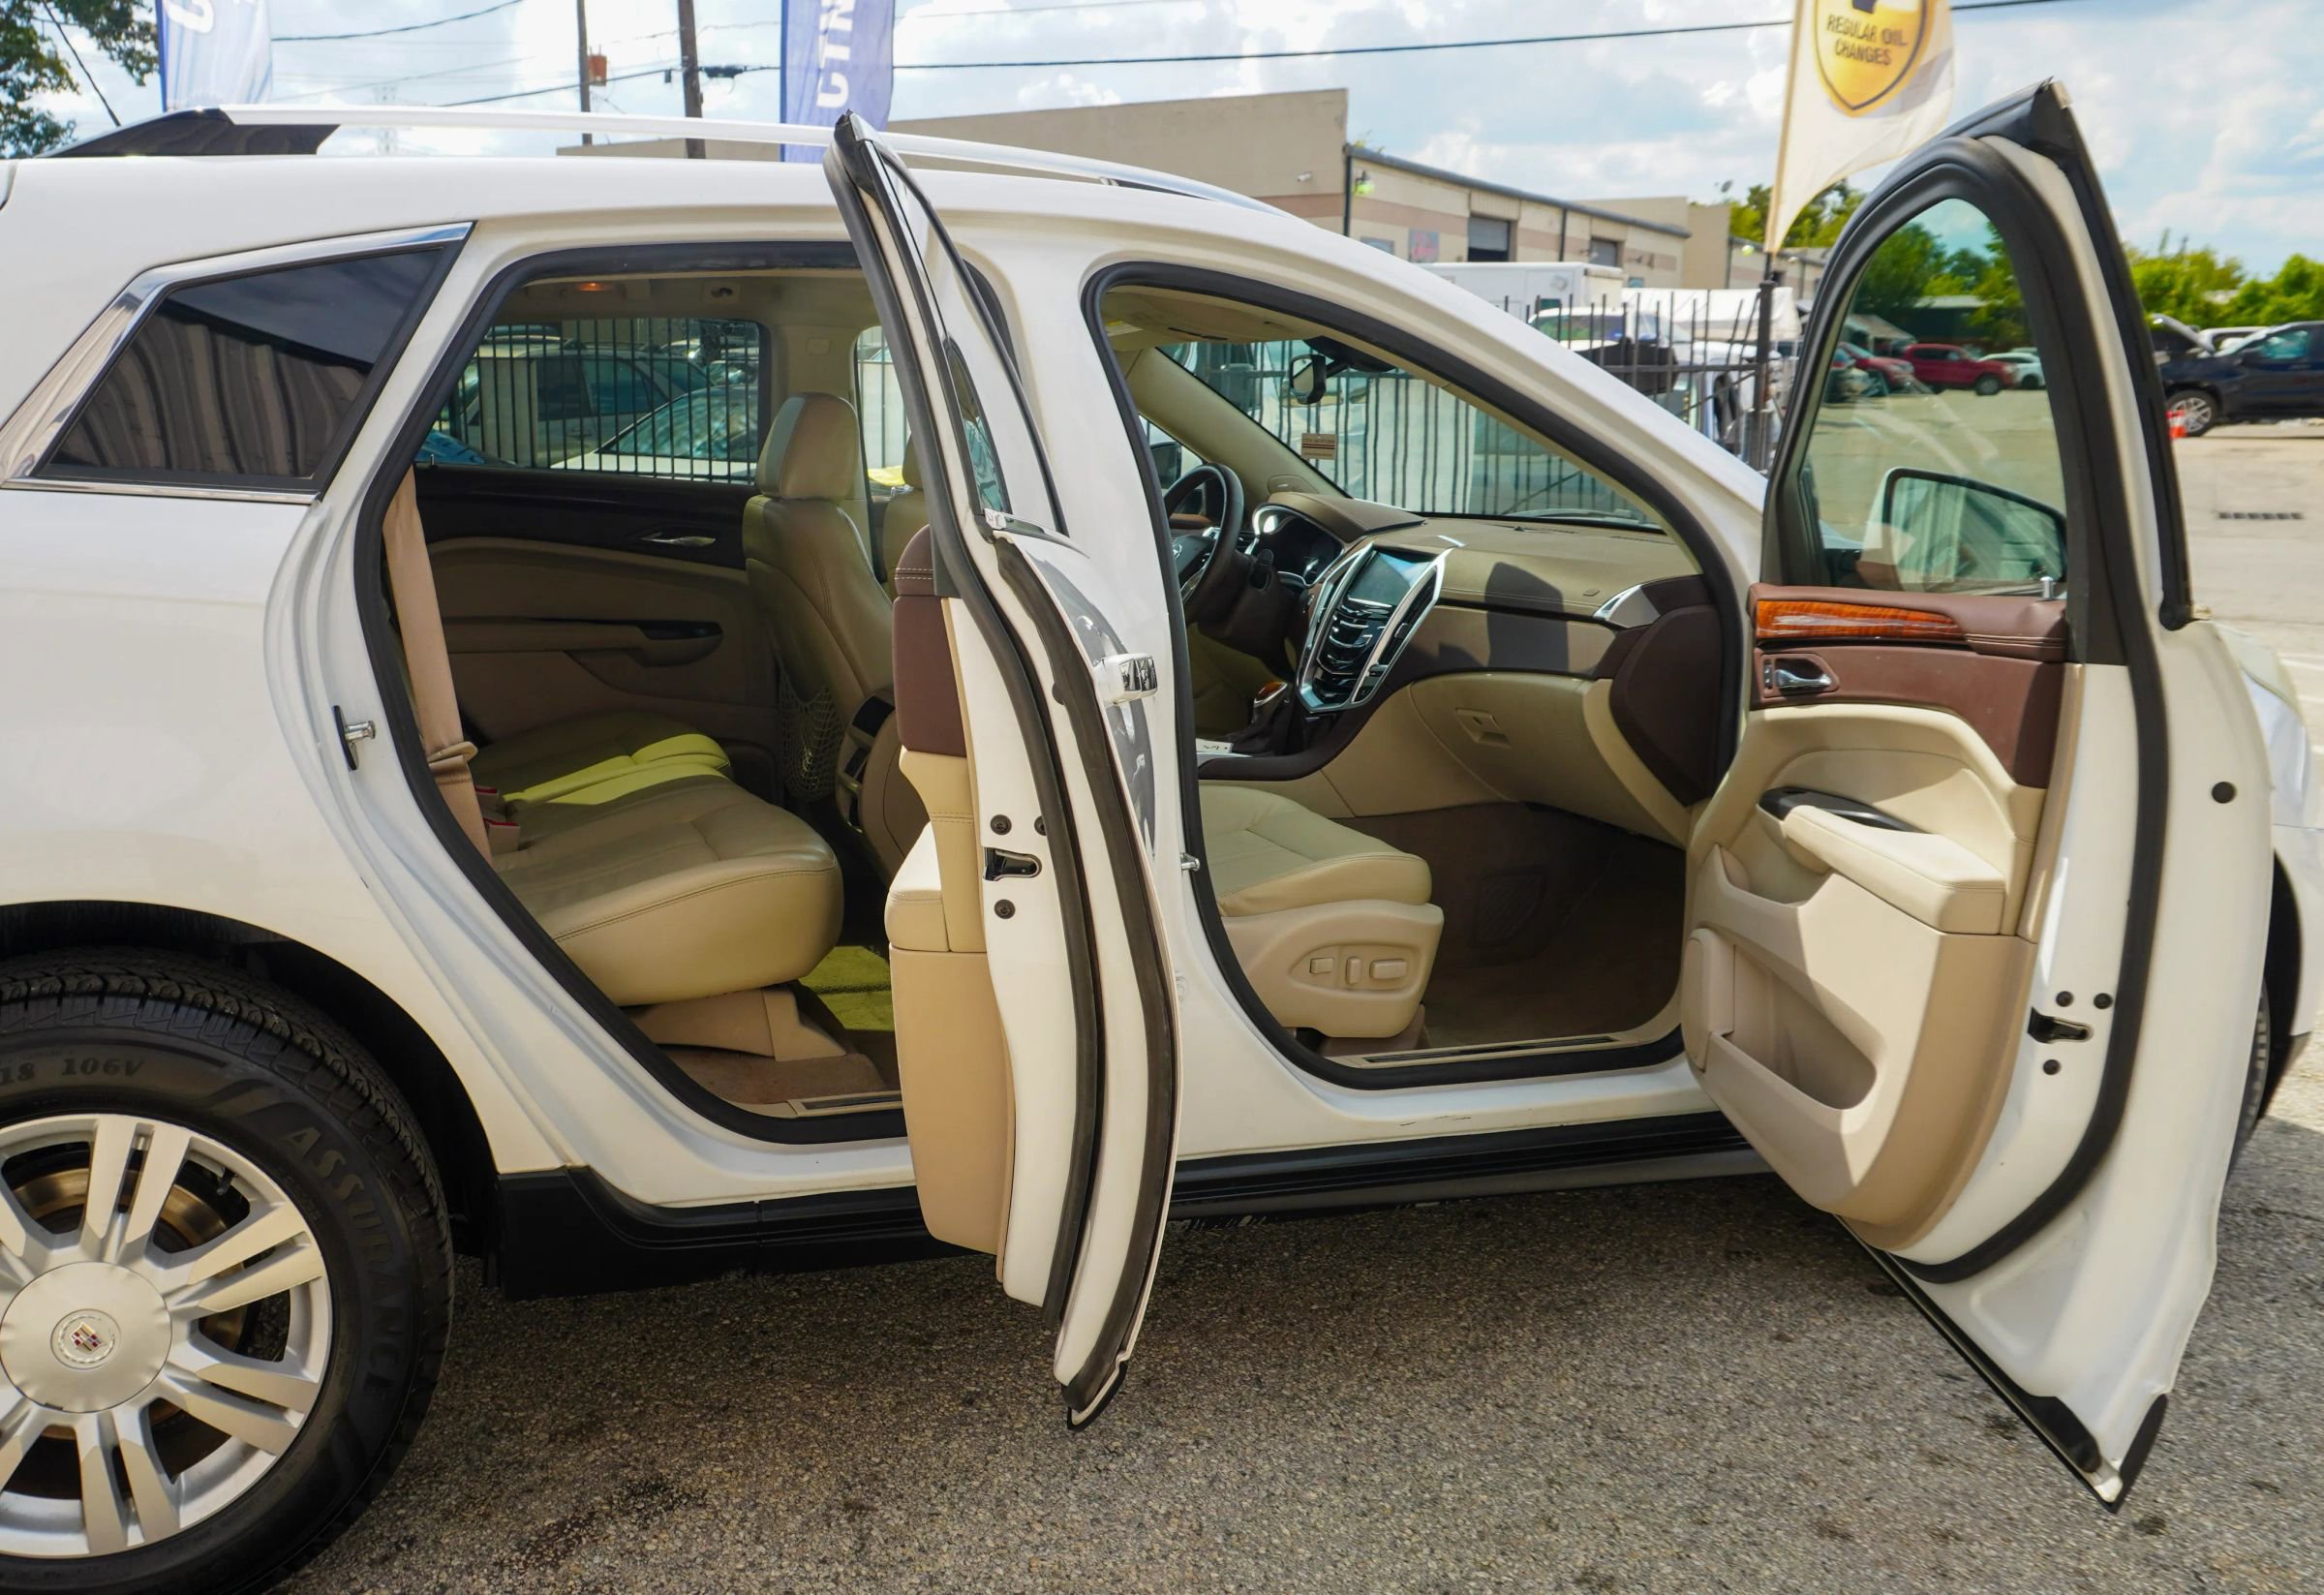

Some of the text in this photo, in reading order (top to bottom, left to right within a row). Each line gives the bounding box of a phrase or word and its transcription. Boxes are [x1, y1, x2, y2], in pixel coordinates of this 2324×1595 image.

[1826, 14, 1909, 46] REGULAR OIL
[1834, 38, 1892, 66] CHANGES
[0, 1058, 146, 1086] 18 106V
[281, 1125, 403, 1398] ASSURANCE
